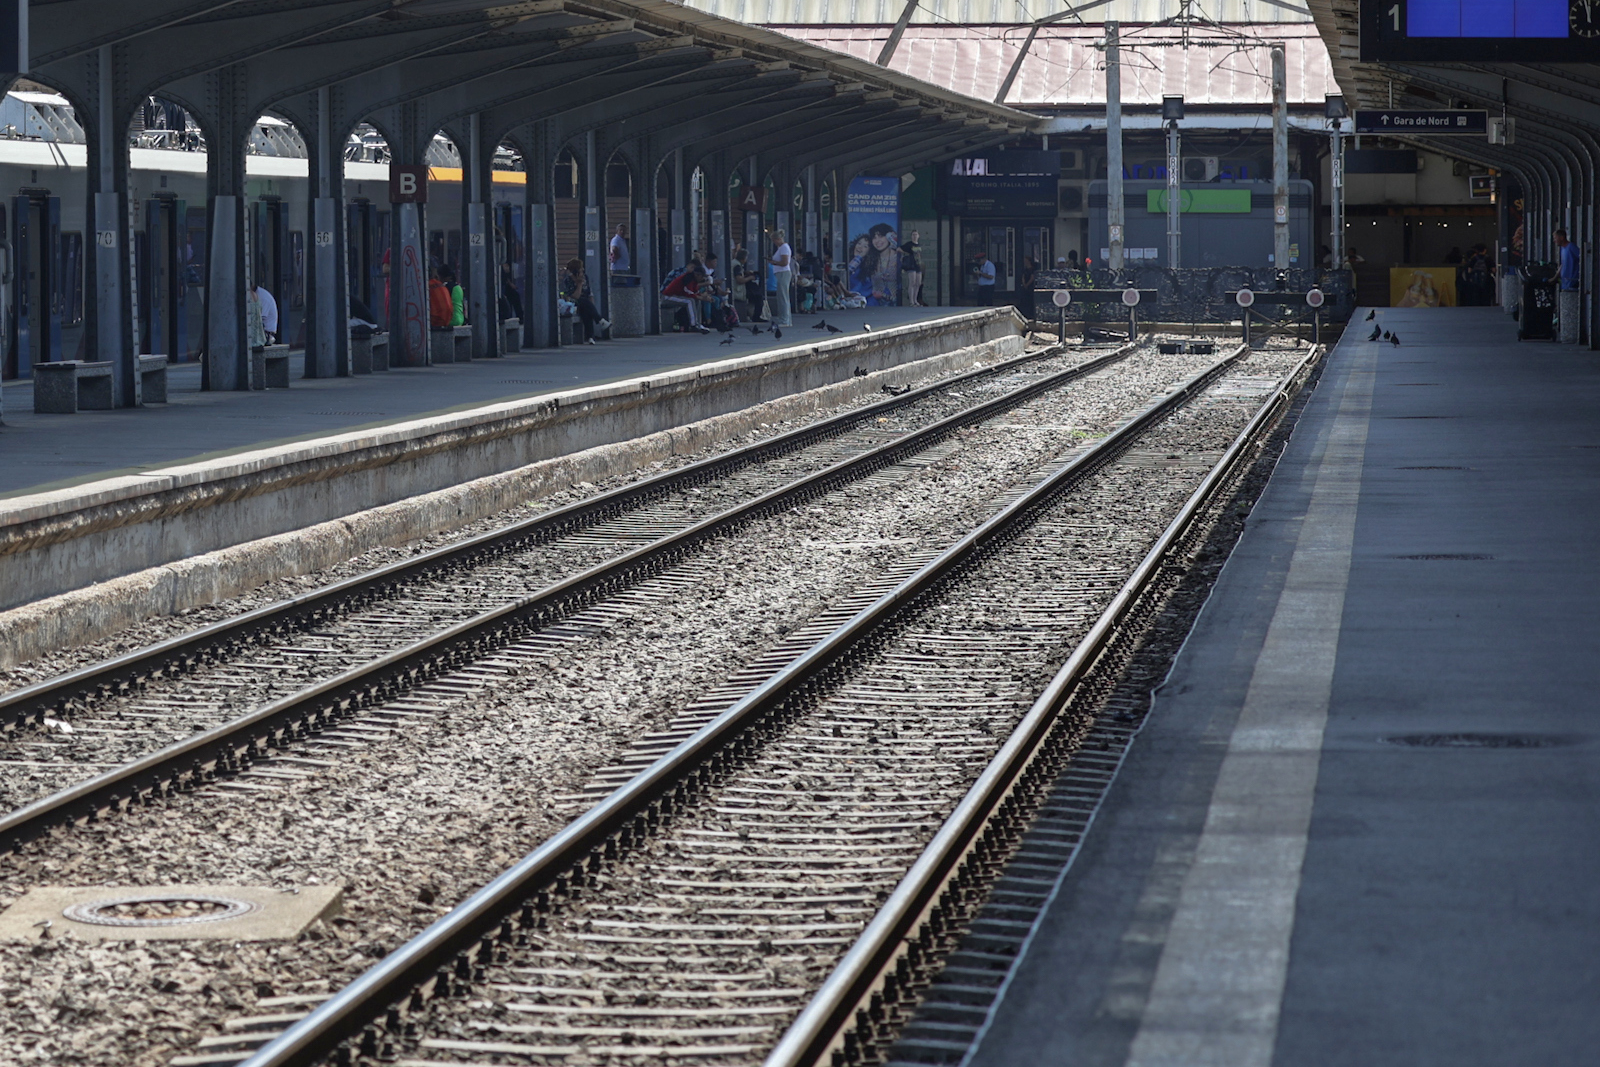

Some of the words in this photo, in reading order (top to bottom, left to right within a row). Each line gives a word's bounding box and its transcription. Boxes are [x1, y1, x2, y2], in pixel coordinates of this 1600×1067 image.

[1388, 4, 1400, 31] 1
[1394, 116, 1414, 126] Gara
[1416, 116, 1427, 126] de
[1428, 116, 1450, 126] Nord
[400, 172, 417, 195] B
[743, 190, 757, 206] A
[97, 231, 112, 246] 70
[316, 231, 329, 245] 56
[470, 233, 482, 245] 42
[586, 231, 596, 241] 28
